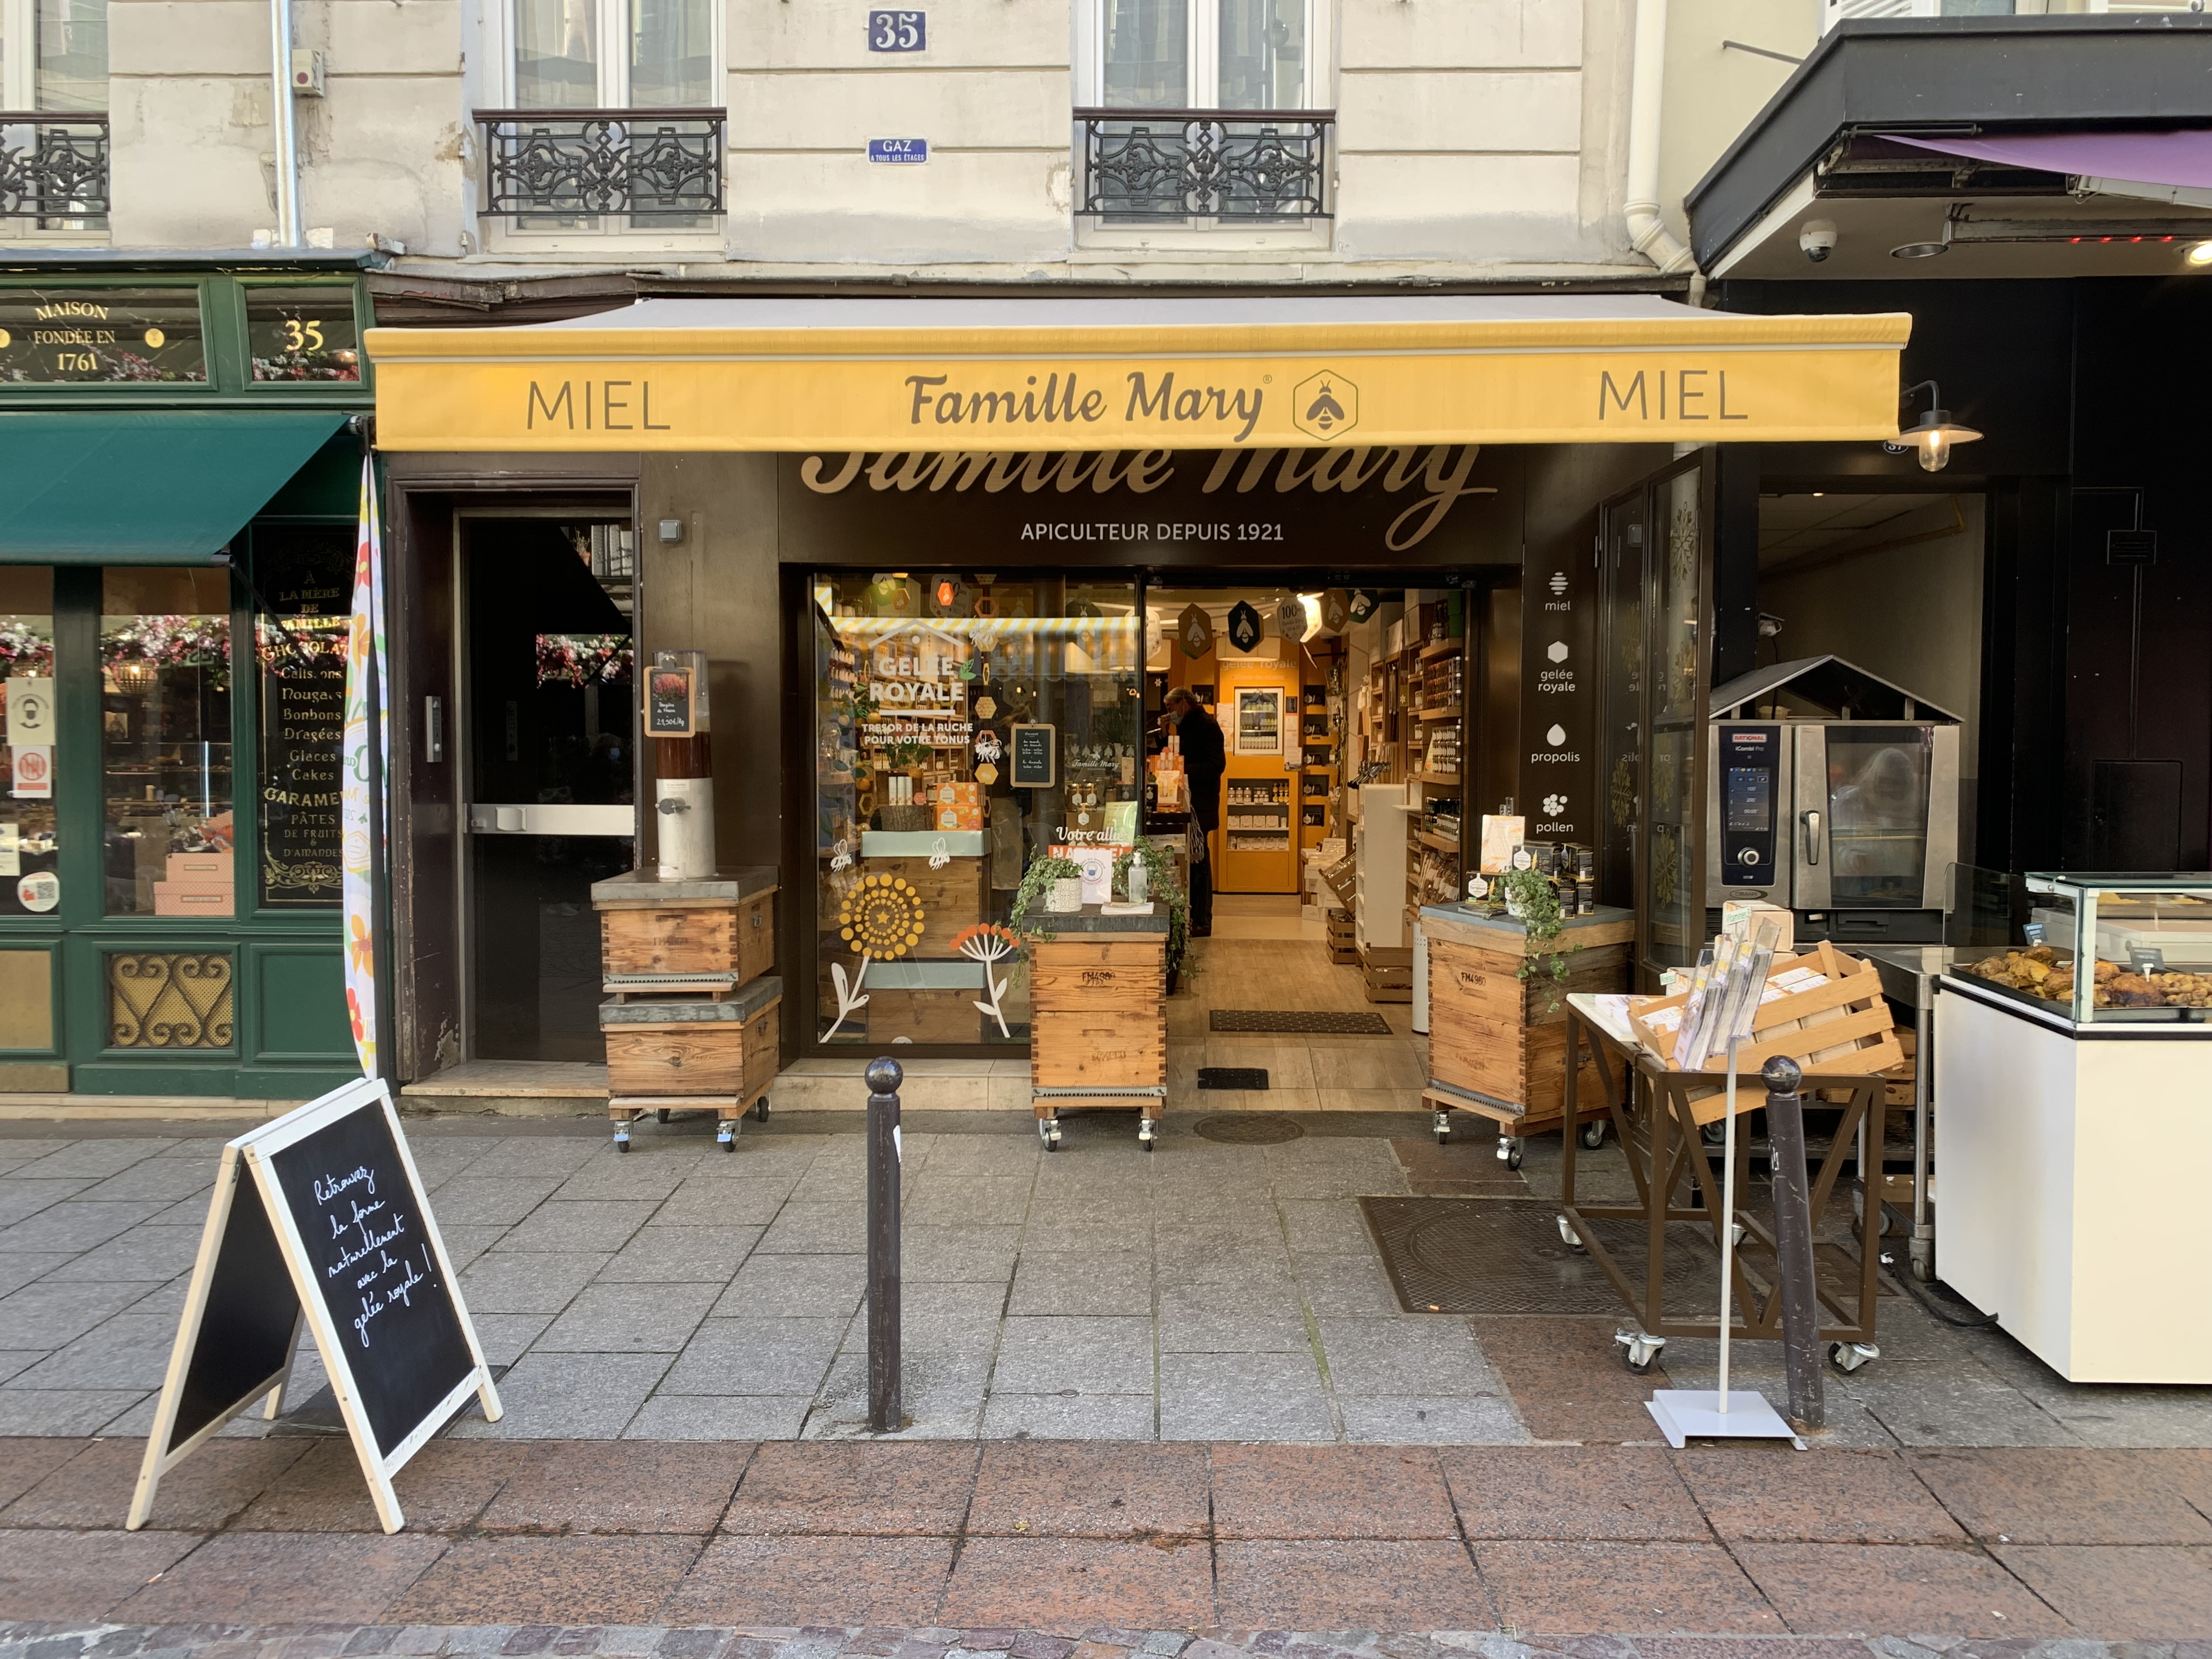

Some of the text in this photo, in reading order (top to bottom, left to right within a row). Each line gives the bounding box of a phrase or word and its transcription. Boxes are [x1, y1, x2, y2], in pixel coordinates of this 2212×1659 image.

[876, 13, 918, 48] 35
[883, 140, 912, 153] GAZ
[904, 152, 925, 162] ÉTAGES
[35, 301, 109, 321] MAISON
[34, 328, 115, 345] FONDÉE EN
[284, 320, 324, 351] 35
[57, 353, 98, 371] 1761
[1598, 370, 1748, 420] MIEL
[527, 381, 671, 430] MIEL
[905, 371, 1263, 443] Famille Mary
[1020, 523, 1284, 540] APICULTEUR DEPUIS 1921
[279, 590, 298, 601] LA
[301, 603, 319, 613] DE
[1545, 600, 1571, 611] miel
[281, 616, 341, 630] AMILLE
[281, 667, 342, 679] Calisons
[1541, 669, 1573, 682] gelée
[870, 682, 964, 702] ROYALE
[1538, 681, 1576, 693] royale
[282, 687, 342, 703] Nougas
[283, 708, 341, 720] Bonbons
[905, 723, 919, 732] DE
[921, 723, 935, 732] LA
[937, 723, 973, 732] RUCHE
[285, 727, 341, 743] Dragées
[865, 735, 970, 745] POUR VOTRE TONUS
[290, 749, 336, 762] Glaces
[1531, 752, 1580, 764] propolis
[1099, 760, 1120, 771] Mary
[292, 769, 334, 781] Cakes
[291, 811, 336, 825] PÂTES
[284, 829, 342, 838] DE FRUITS
[1056, 826, 1093, 841] Votre
[1536, 822, 1574, 834] pollen
[314, 1165, 375, 1206] Retrouvez
[330, 1200, 385, 1240] la forme
[328, 1213, 404, 1278] naturellement
[357, 1250, 398, 1290] avec la
[354, 1291, 383, 1348] gelée
[387, 1261, 424, 1307] royale
